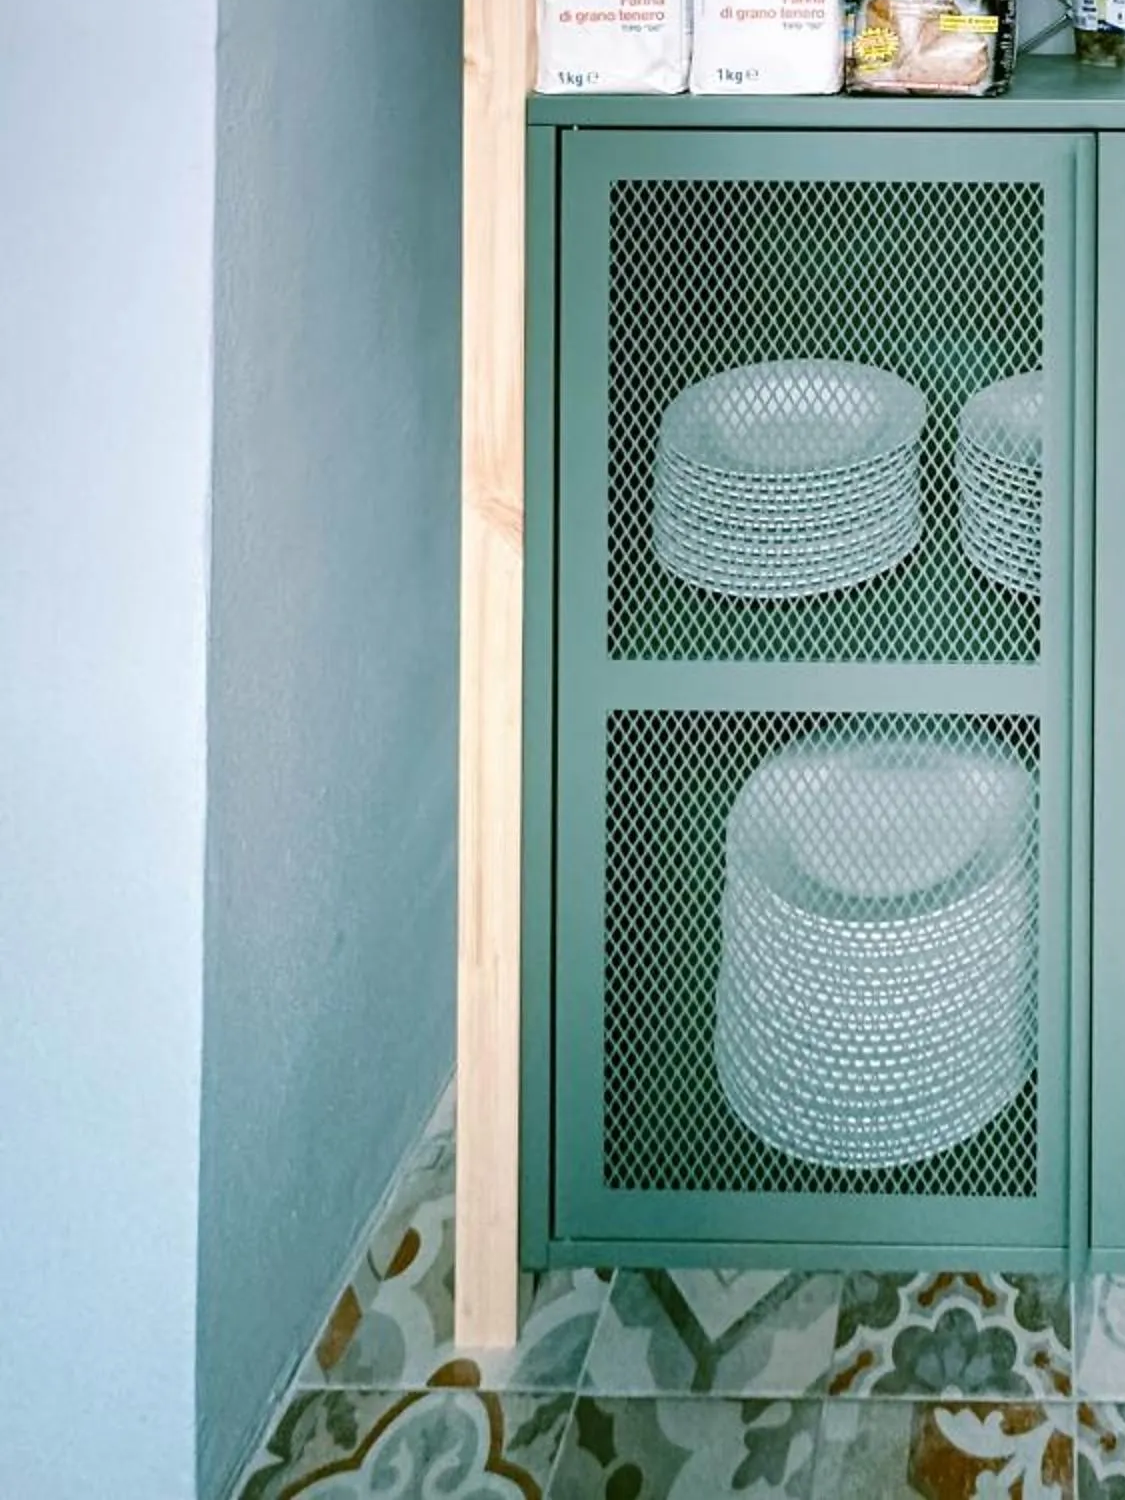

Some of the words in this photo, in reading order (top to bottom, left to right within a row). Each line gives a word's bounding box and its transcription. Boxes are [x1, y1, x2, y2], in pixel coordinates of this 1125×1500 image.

[576, 11, 617, 25] grano
[620, 9, 665, 21] tenero
[720, 7, 732, 19] di
[736, 8, 777, 22] grano
[780, 7, 825, 19] tenero
